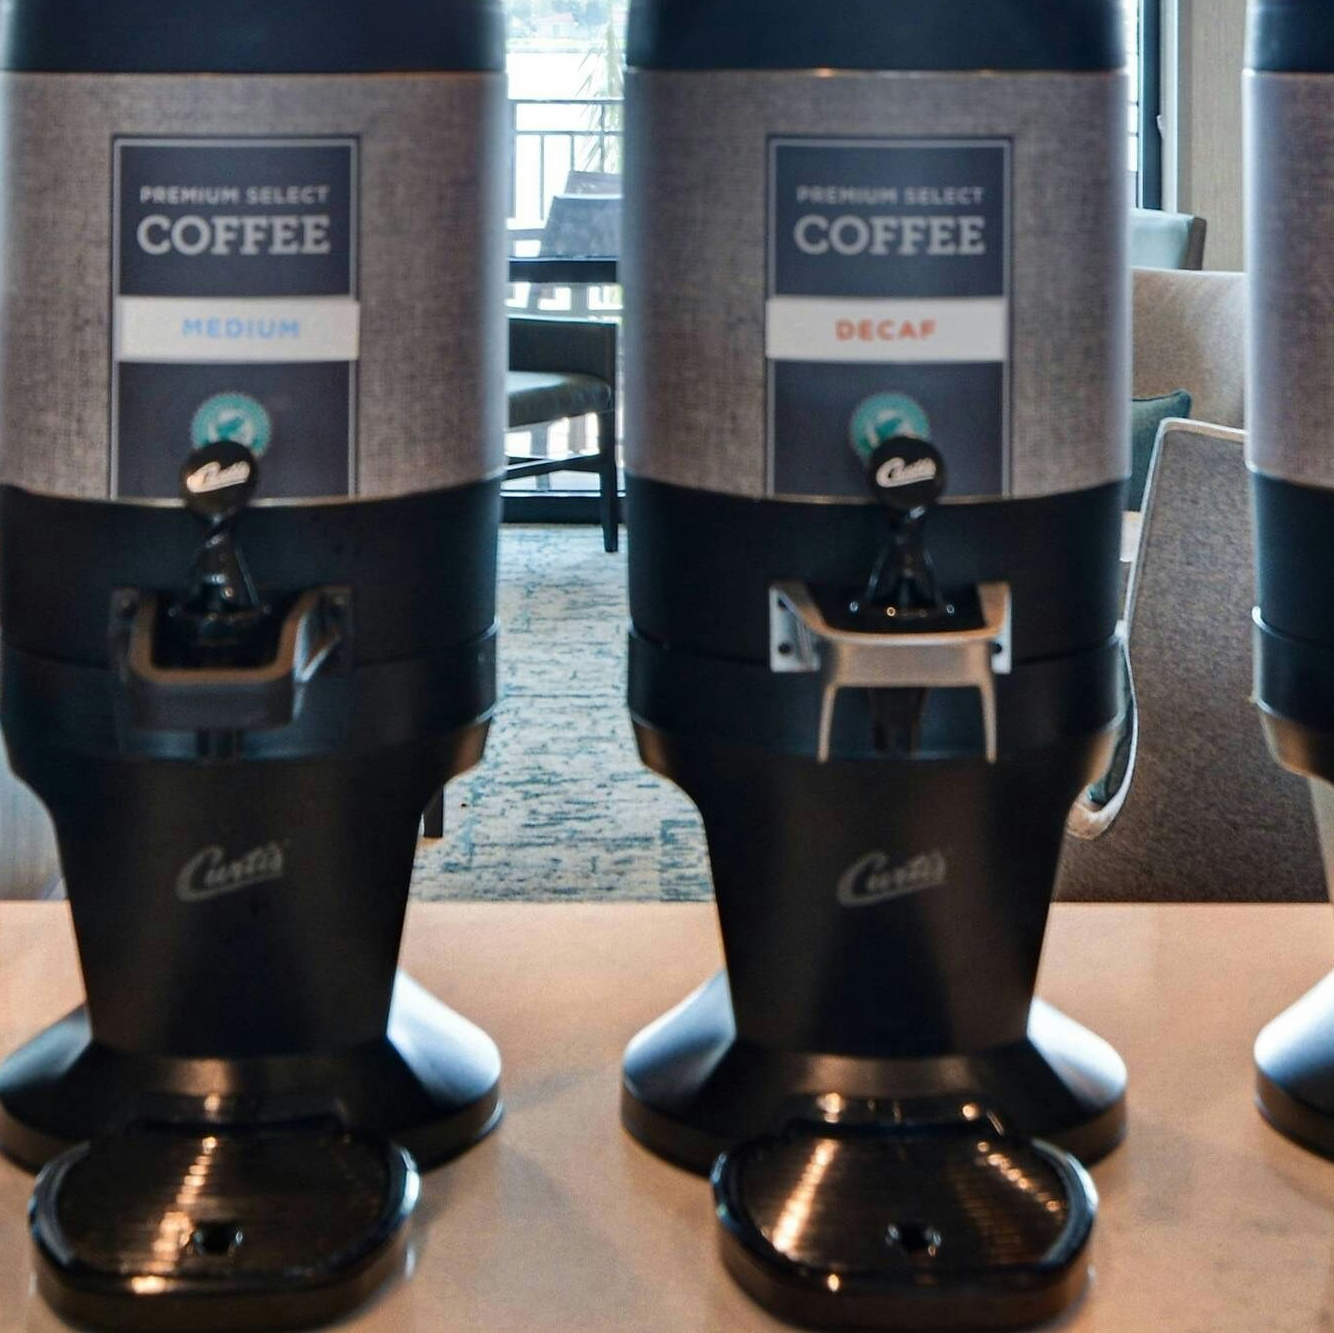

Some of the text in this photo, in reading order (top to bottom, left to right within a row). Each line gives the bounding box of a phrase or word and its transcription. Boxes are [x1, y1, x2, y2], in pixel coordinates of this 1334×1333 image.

[139, 185, 331, 205] PREMIUM SELECT
[796, 186, 984, 206] PREMIUM SELECT
[136, 215, 331, 256] COFFEE
[793, 215, 986, 256] COFFEE
[182, 317, 301, 339] MEDIUM
[835, 319, 937, 342] DECAF
